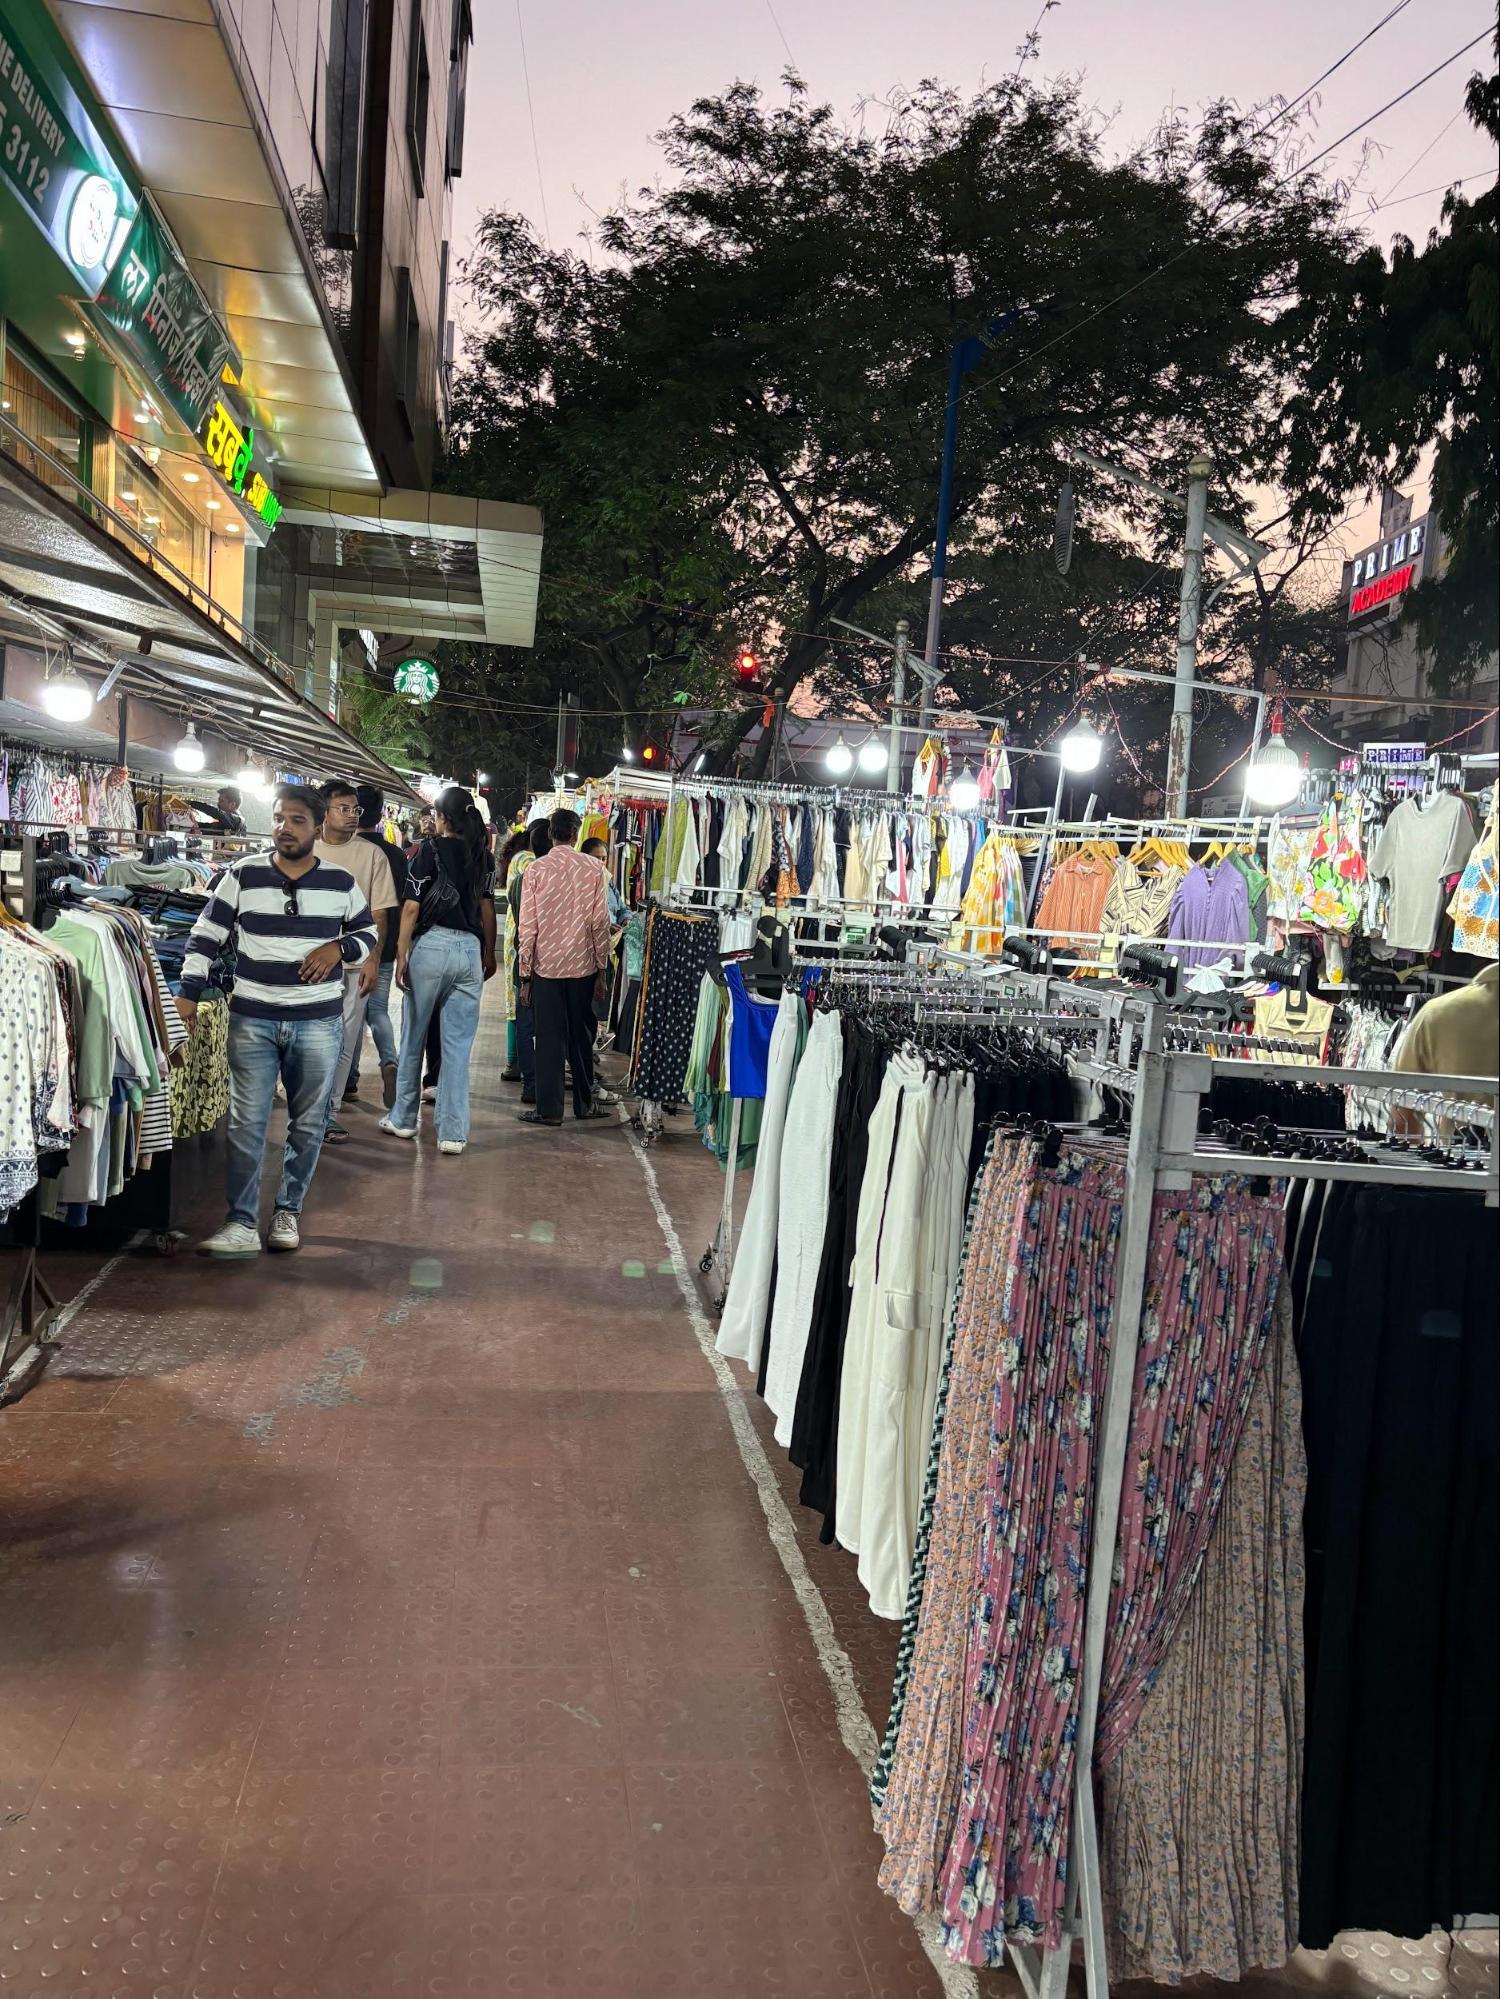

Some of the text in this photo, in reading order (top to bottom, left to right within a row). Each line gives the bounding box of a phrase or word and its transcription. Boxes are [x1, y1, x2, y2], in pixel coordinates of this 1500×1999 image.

[11, 62, 65, 156] DELIVERY
[6, 124, 49, 203] 3112
[120, 248, 149, 306] ला
[207, 400, 254, 494] सबवे
[1352, 526, 1423, 587] PRIME
[1351, 563, 1415, 614] ACADEMY
[1367, 748, 1423, 762] PRIME
